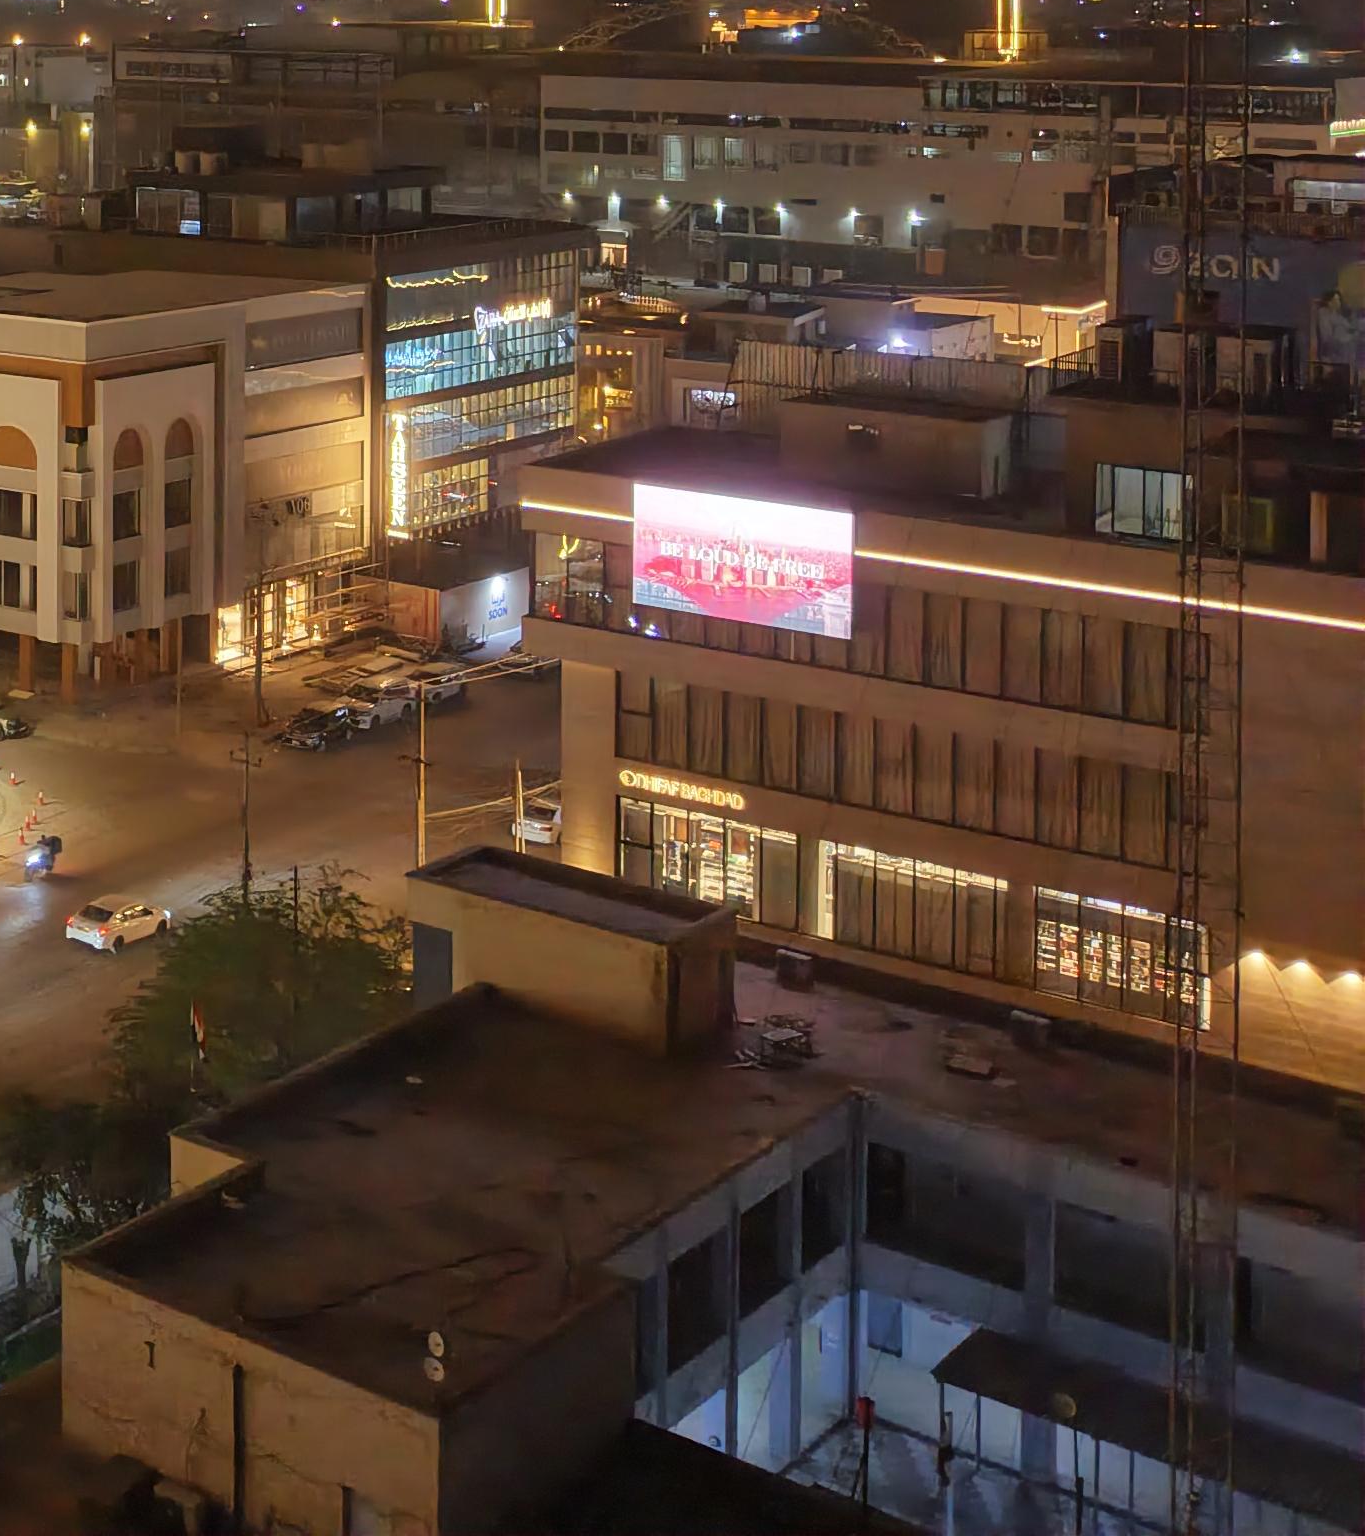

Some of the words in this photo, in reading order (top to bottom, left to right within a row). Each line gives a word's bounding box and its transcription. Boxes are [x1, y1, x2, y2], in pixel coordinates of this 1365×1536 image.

[390, 413, 407, 526] TAHSEEN
[660, 541, 684, 558] BE
[689, 545, 740, 566] LOUD
[744, 552, 768, 571] BE
[773, 557, 825, 579] FREE
[488, 607, 508, 620] SOON
[680, 783, 745, 810] BAGHDAD
